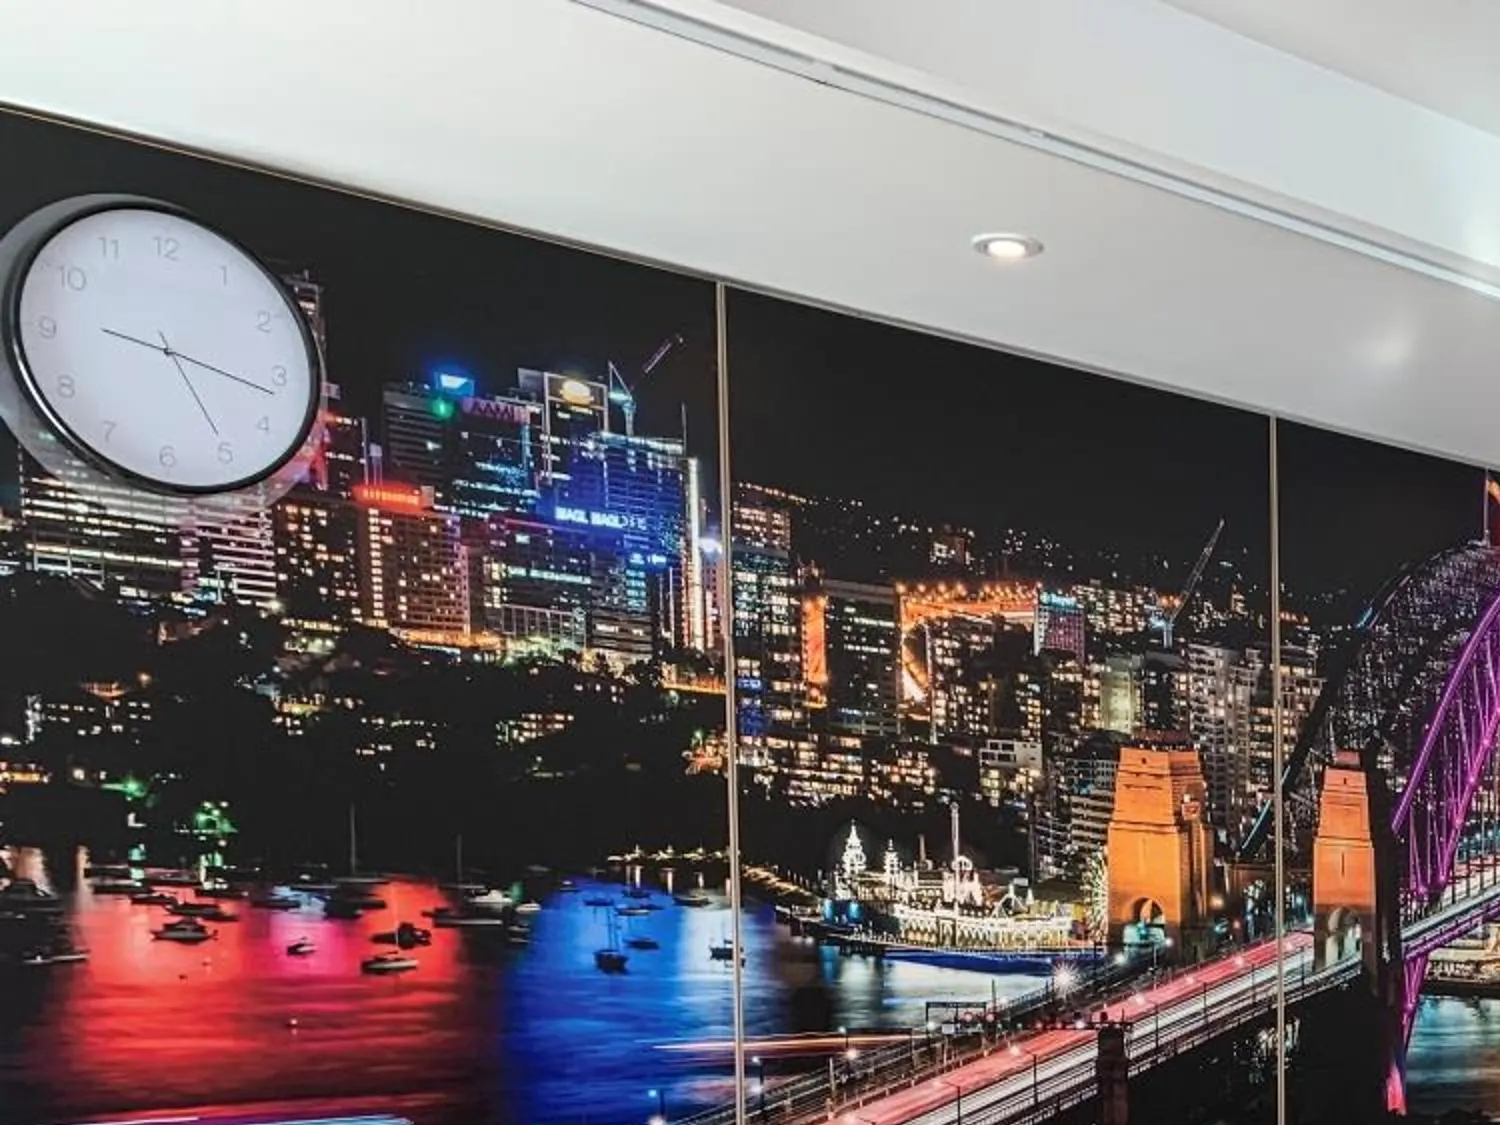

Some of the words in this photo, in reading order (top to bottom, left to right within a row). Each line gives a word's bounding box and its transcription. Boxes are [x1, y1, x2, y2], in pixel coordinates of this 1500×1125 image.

[98, 237, 120, 259] 11
[153, 236, 180, 261] 12
[59, 266, 87, 292] 10
[220, 266, 228, 285] 1
[38, 316, 57, 339] 9
[255, 311, 272, 333] 2
[57, 375, 75, 399] 8
[272, 365, 288, 387] 3
[102, 421, 117, 442] 7
[255, 416, 270, 434] 4
[159, 445, 177, 467] 6
[217, 443, 234, 464] 5
